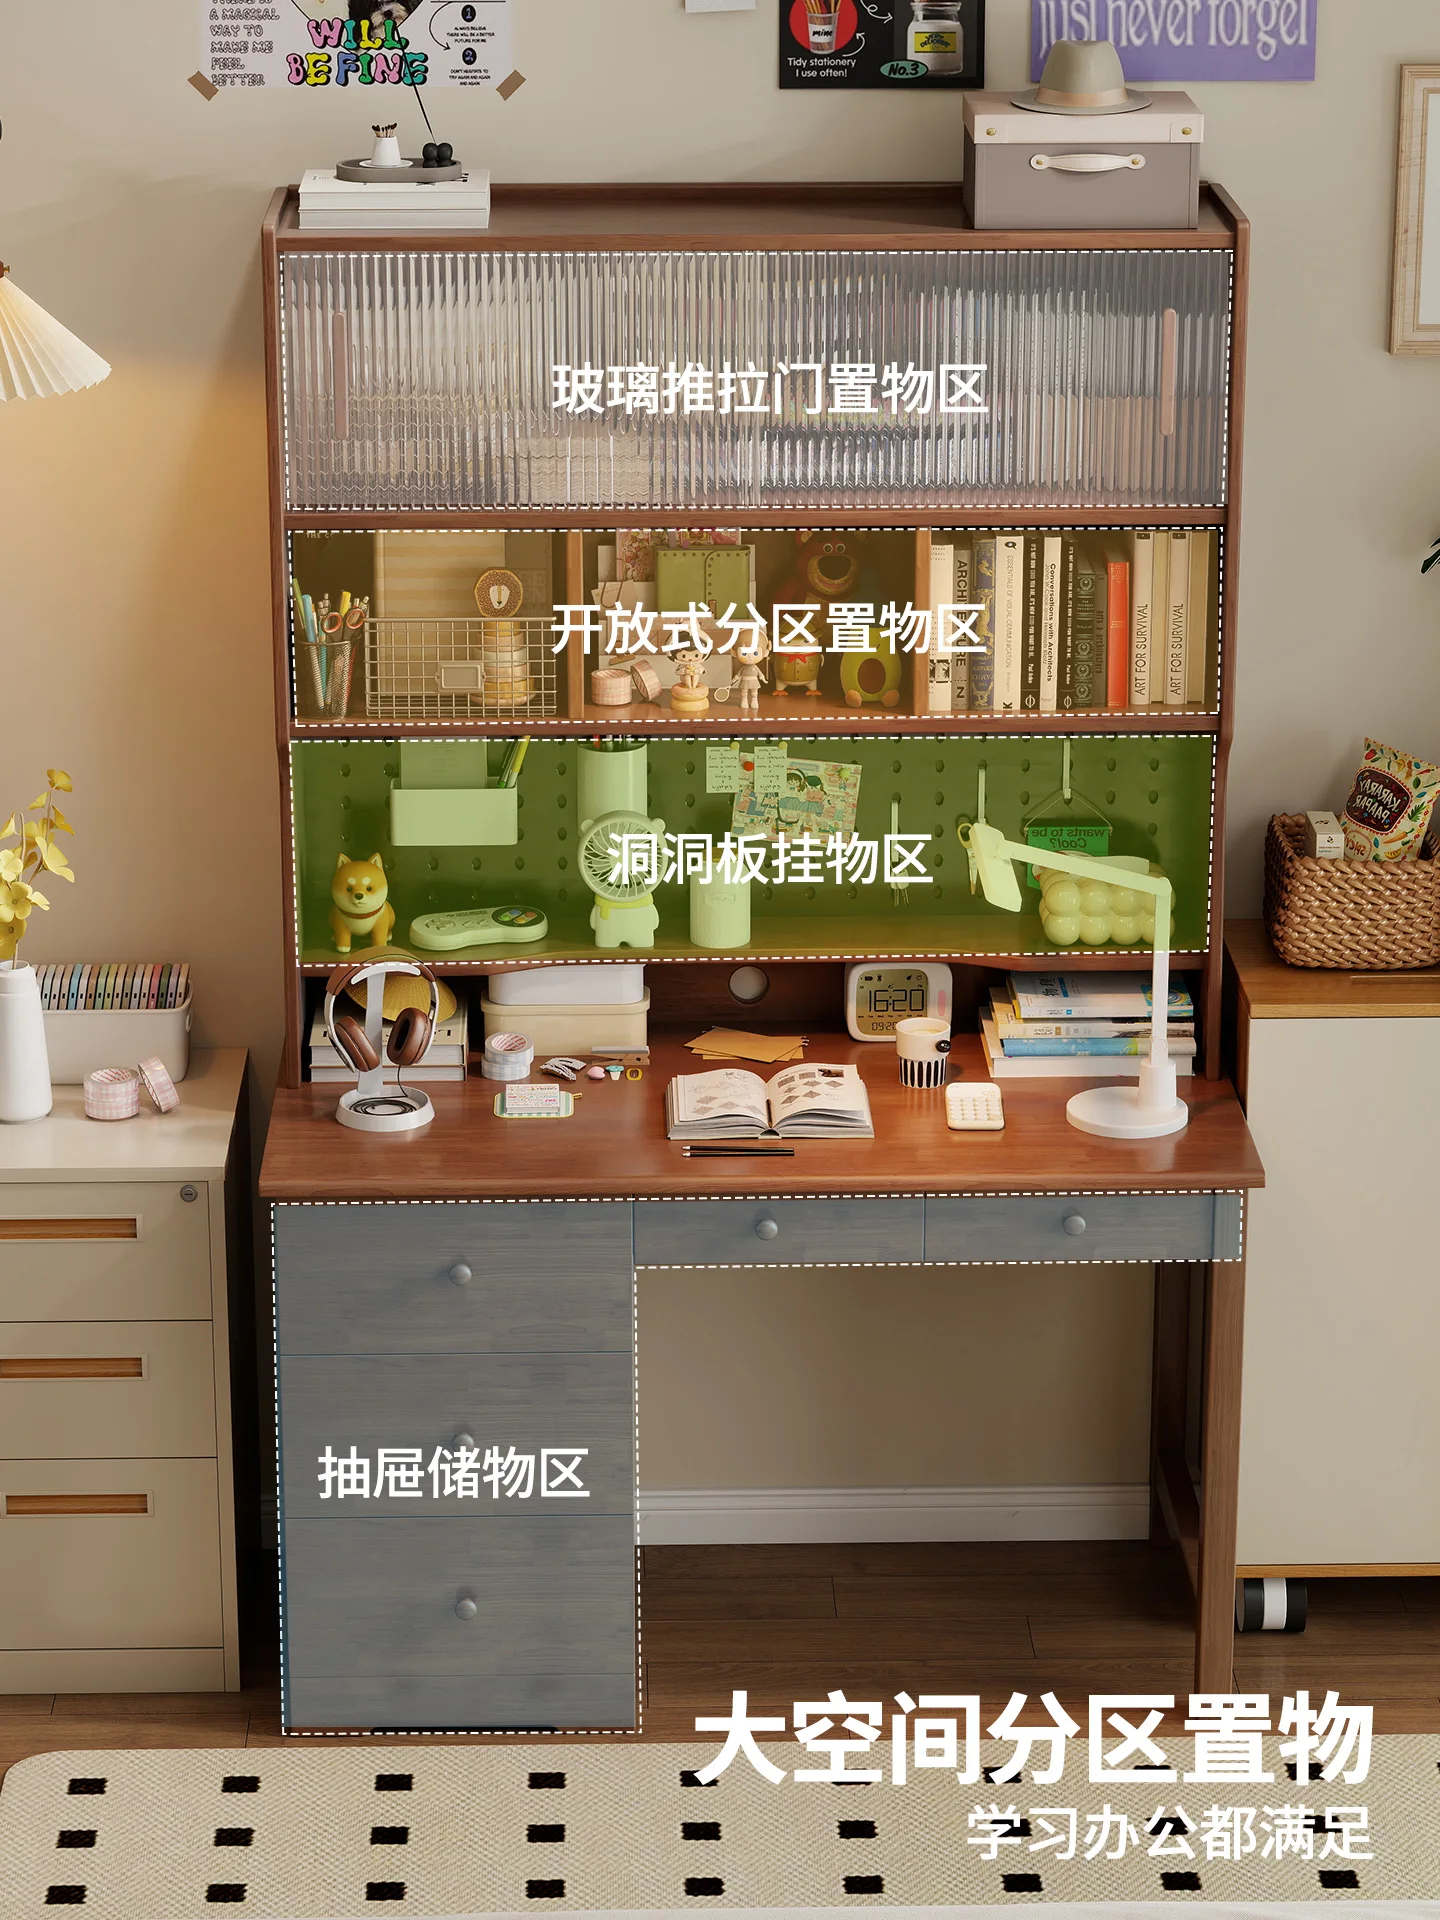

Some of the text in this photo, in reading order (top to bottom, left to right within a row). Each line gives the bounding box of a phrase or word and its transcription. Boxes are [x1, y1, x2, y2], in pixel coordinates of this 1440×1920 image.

[209, 8, 280, 21] A MAGICAL
[466, 8, 472, 18] 1
[1109, 0, 1200, 47] never
[210, 24, 263, 37] WAY TO
[307, 17, 409, 49] WILL
[211, 41, 273, 54] MAKE ME
[465, 50, 473, 61] 2
[211, 57, 245, 70] FEEL
[286, 52, 428, 86] BE FINE
[788, 57, 856, 68] Tidy stationery
[820, 69, 847, 77] often!
[888, 63, 919, 76] No.3
[211, 73, 265, 86] BETTER
[1006, 591, 1013, 599] OF
[956, 560, 968, 667] ARCHIETURE
[1135, 604, 1148, 695] ART FOR SURVIVAL
[1170, 604, 1183, 695] ART FOR SURVIVAL
[956, 687, 964, 698] N
[869, 989, 924, 1012] 16:20
